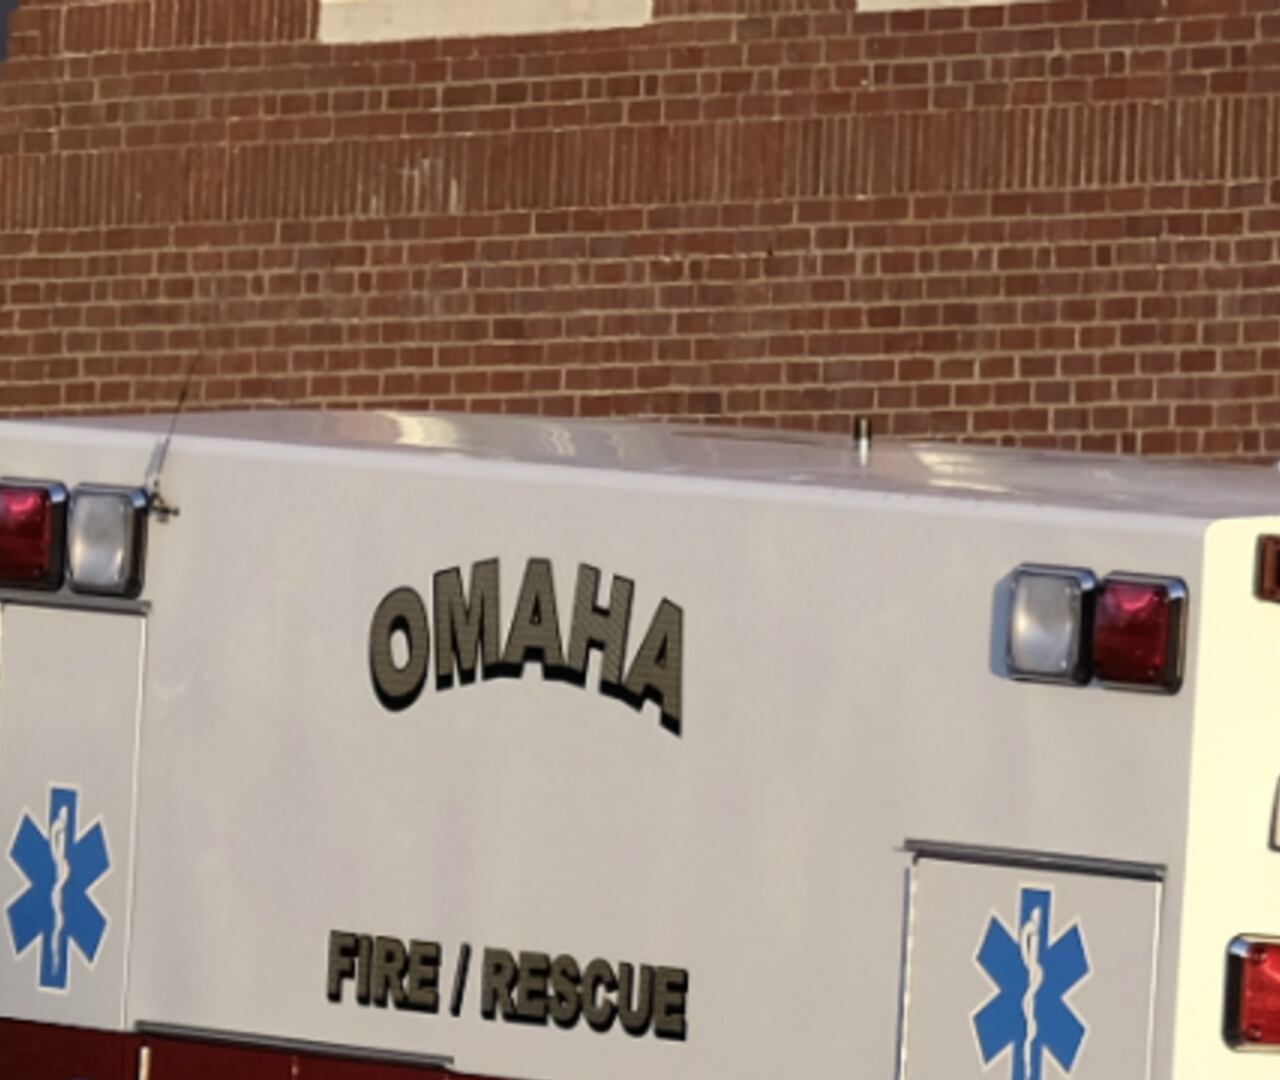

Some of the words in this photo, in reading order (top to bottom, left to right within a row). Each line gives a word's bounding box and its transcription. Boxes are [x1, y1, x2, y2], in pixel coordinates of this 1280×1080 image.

[369, 557, 683, 738] OMAHA
[327, 929, 442, 1015] FIRE
[450, 943, 471, 1018] /
[480, 946, 689, 1042] RESCUE
